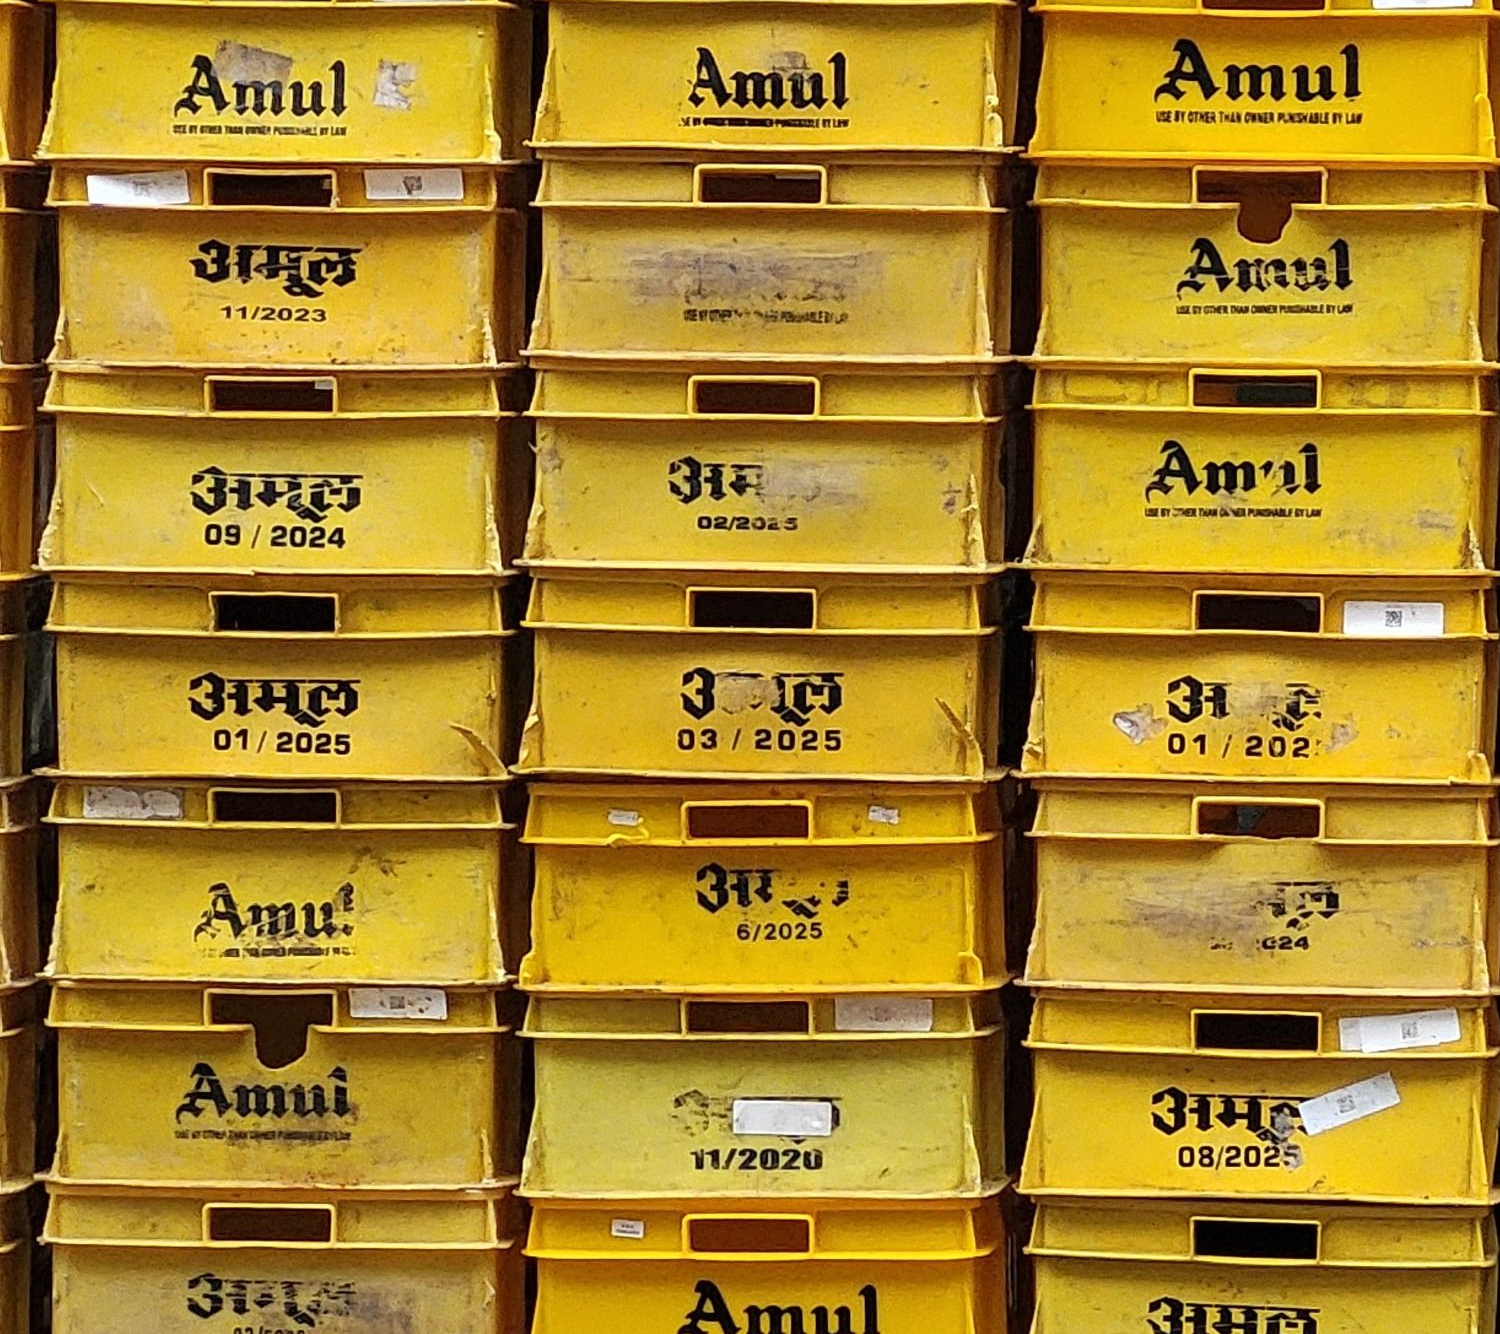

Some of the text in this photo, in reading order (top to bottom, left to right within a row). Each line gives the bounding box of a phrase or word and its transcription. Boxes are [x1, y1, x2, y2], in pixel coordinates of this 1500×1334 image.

[174, 54, 348, 117] Amul
[687, 47, 849, 111] Amul
[1155, 38, 1361, 102] Amul
[1156, 110, 1172, 123] USE
[1219, 111, 1242, 124] THAN
[1345, 112, 1363, 125] LAW
[188, 239, 363, 297] अमूल
[220, 307, 327, 322] 11/2023
[189, 467, 362, 522] अमूल
[204, 524, 240, 548] 09
[270, 526, 346, 548] 2024
[188, 671, 359, 725] अमूल
[213, 729, 249, 751] 01
[276, 732, 351, 756] 2025
[677, 728, 717, 751] 03
[754, 728, 842, 751] 2025
[737, 922, 822, 941] 6/2025
